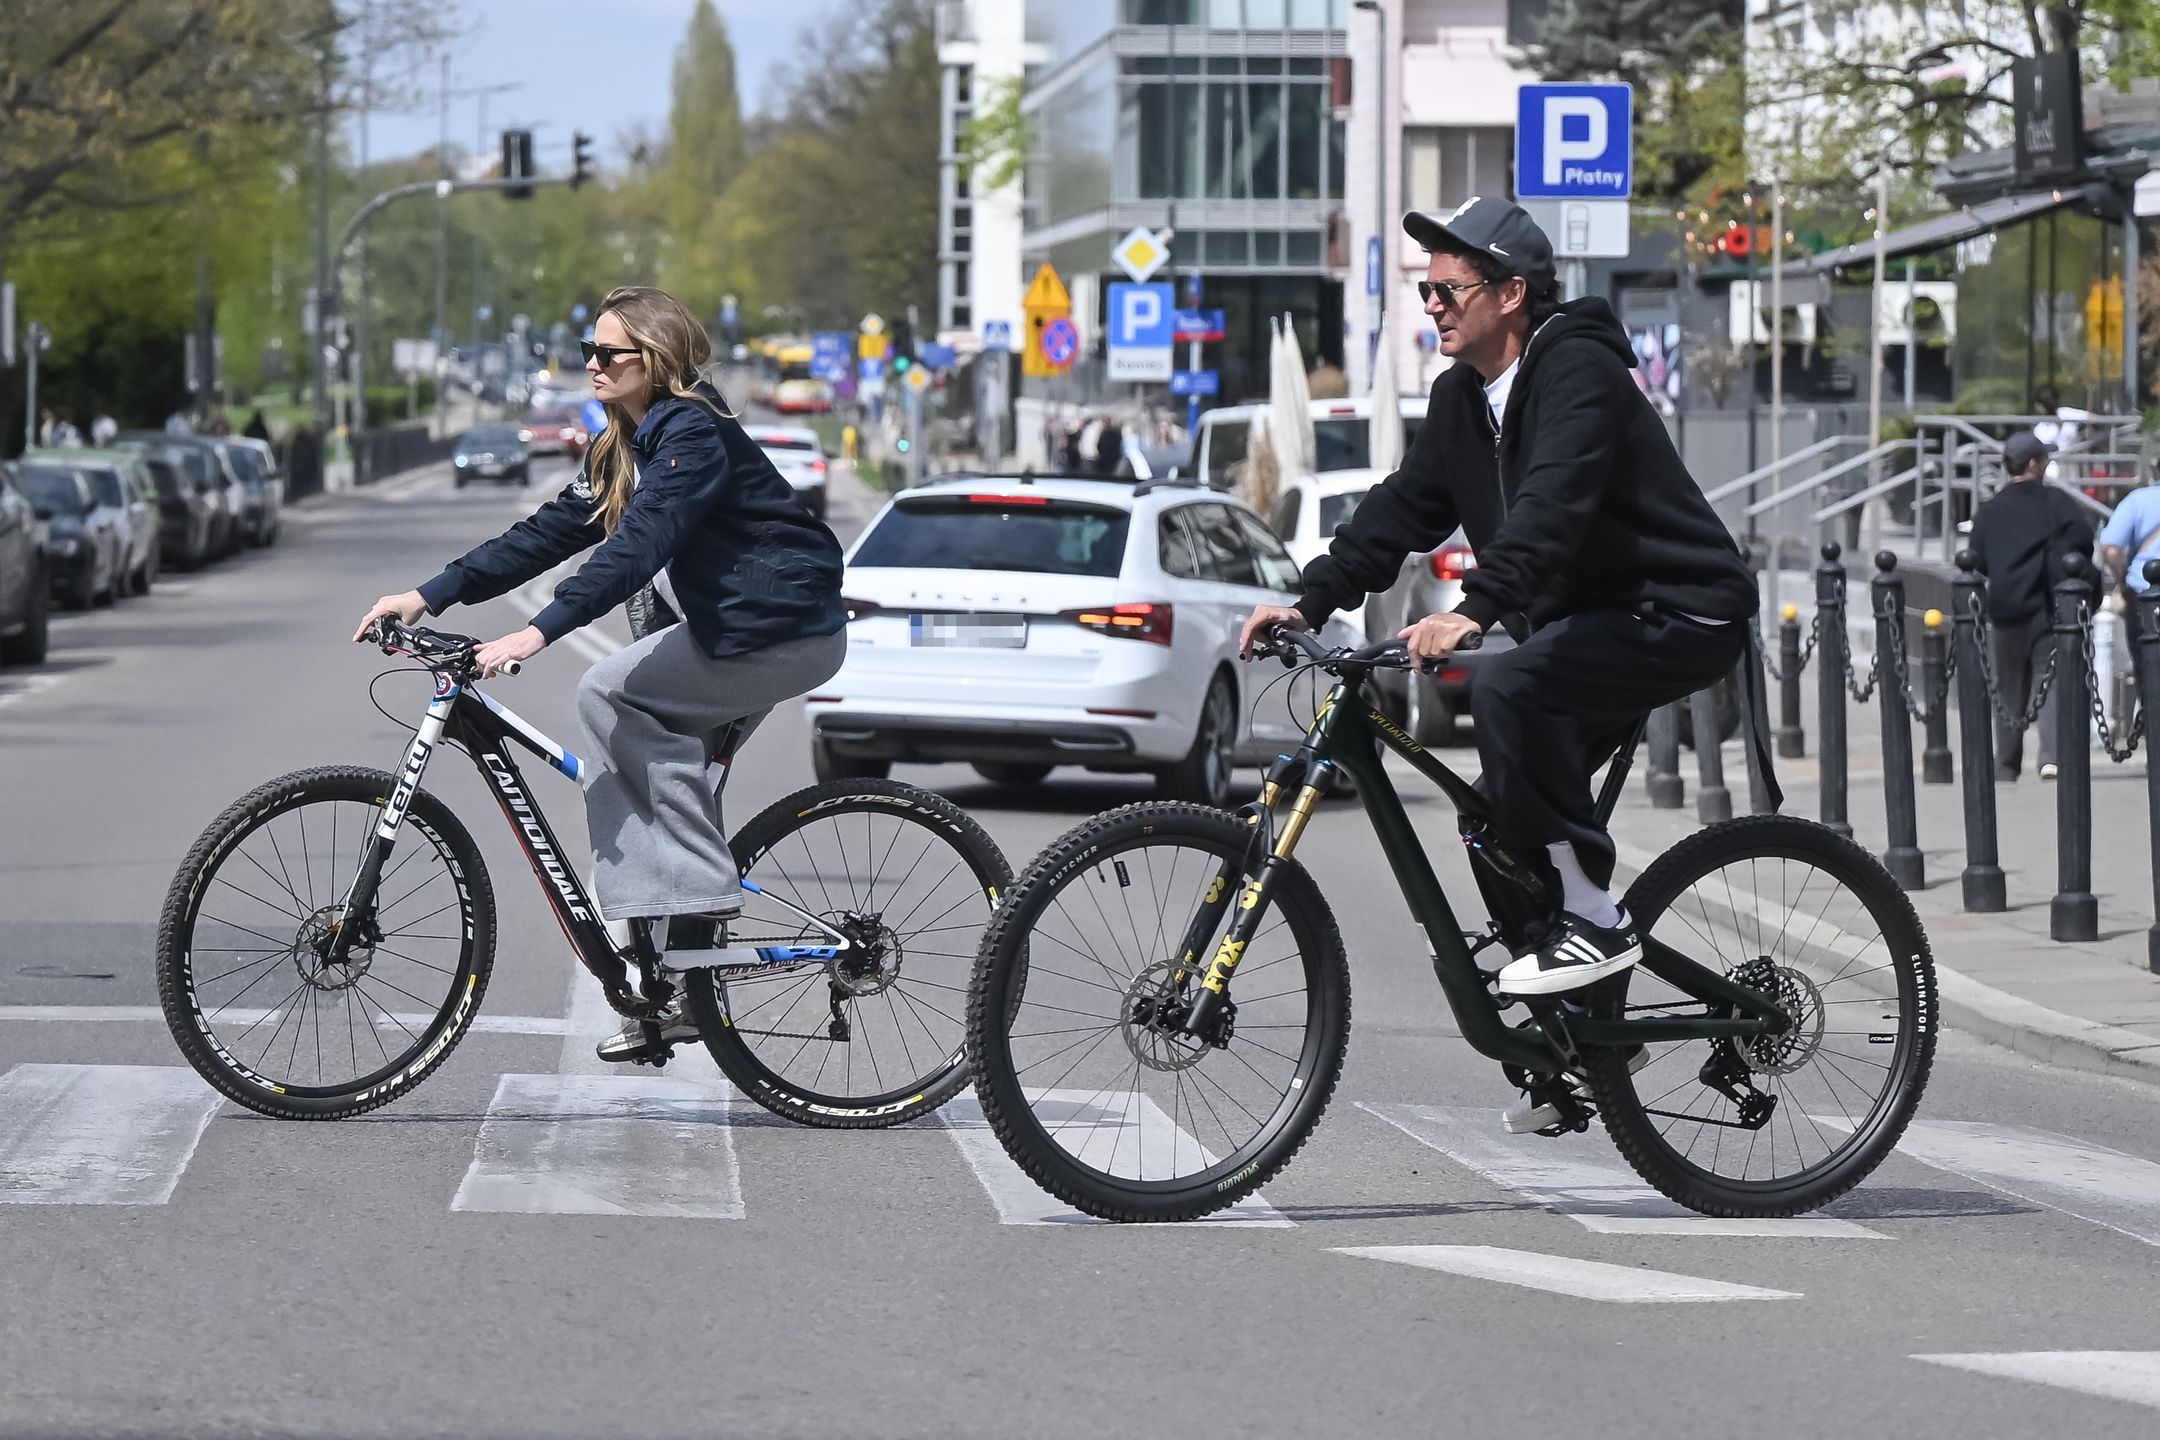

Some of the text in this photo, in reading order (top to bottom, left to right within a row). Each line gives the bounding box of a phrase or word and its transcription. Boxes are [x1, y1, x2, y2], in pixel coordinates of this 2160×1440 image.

[1543, 96, 1608, 186] P
[1123, 290, 1161, 341] P
[1048, 845, 1098, 887] BUTCHER
[1200, 934, 1245, 995] FOX
[1910, 953, 1927, 1033] ELIMINATOR
